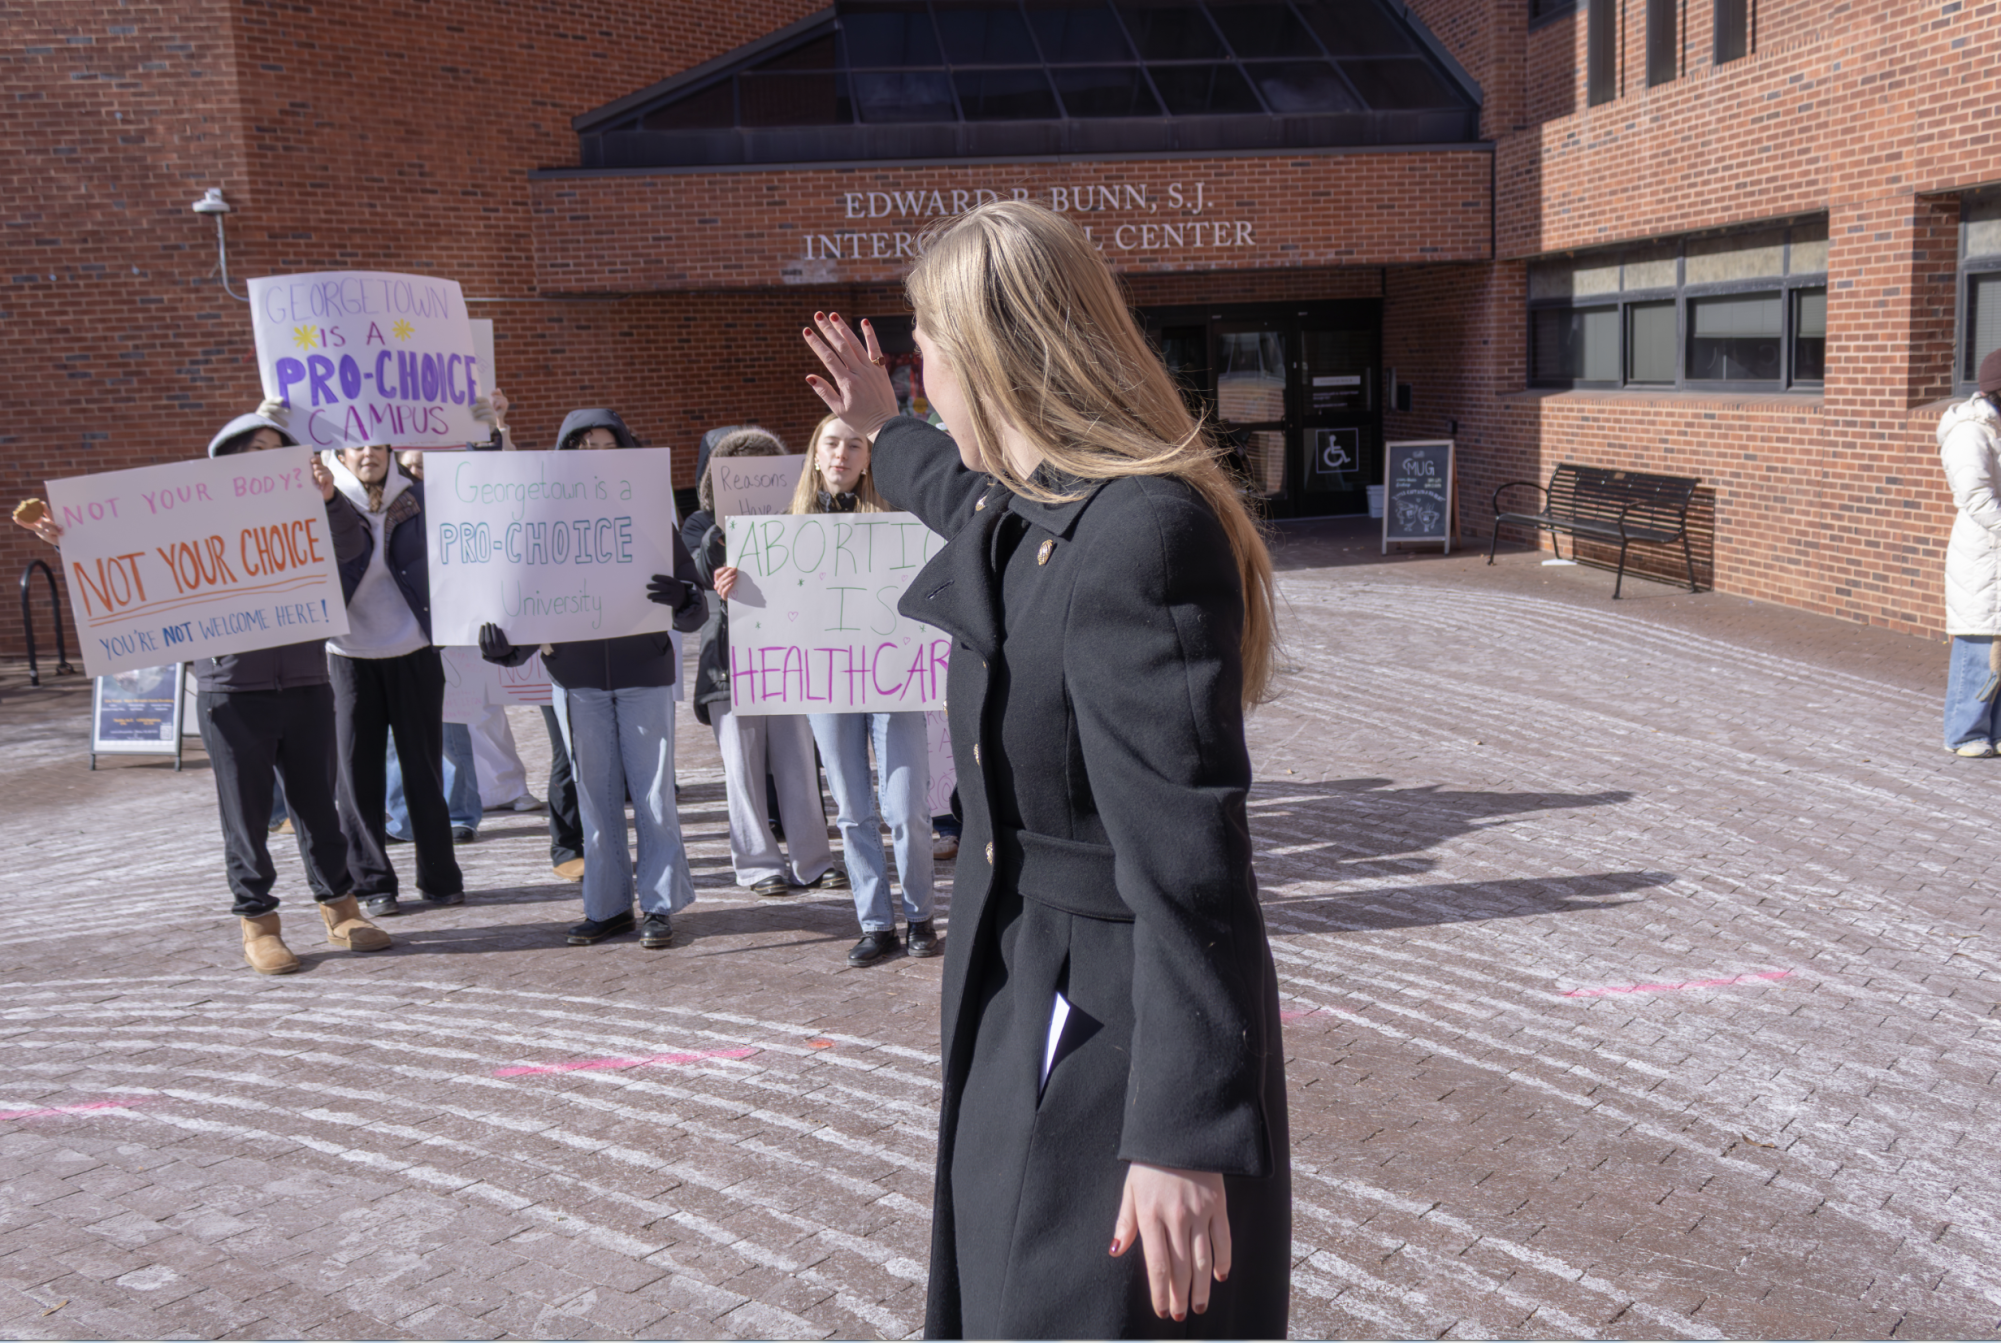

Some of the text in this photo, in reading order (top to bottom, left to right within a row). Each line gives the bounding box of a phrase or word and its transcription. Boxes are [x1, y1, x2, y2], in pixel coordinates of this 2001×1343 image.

[844, 188, 998, 218] EDWARD
[1050, 183, 1157, 213] BUNN,
[1168, 181, 1213, 214] S.J.
[1115, 220, 1255, 251] CENTER
[266, 277, 449, 324] GEORGETOWN
[320, 321, 385, 348] IS A
[275, 349, 478, 410] PRO-CHOICE
[308, 403, 449, 446] CAMPUS
[455, 461, 632, 522] Georgetown is a
[720, 465, 788, 492] Reasons
[1403, 458, 1435, 476] MUG
[62, 467, 304, 528] NOT YOUR BODY?
[439, 516, 633, 565] PRO-CHOICE
[73, 518, 325, 617] NOT YOUR CHOICE
[501, 577, 603, 630] University
[824, 585, 899, 636] IS
[99, 629, 159, 660] YOU'RE
[162, 621, 195, 647] NOT
[198, 608, 271, 640] WELCOME
[732, 638, 951, 706] HEALTHCAR
